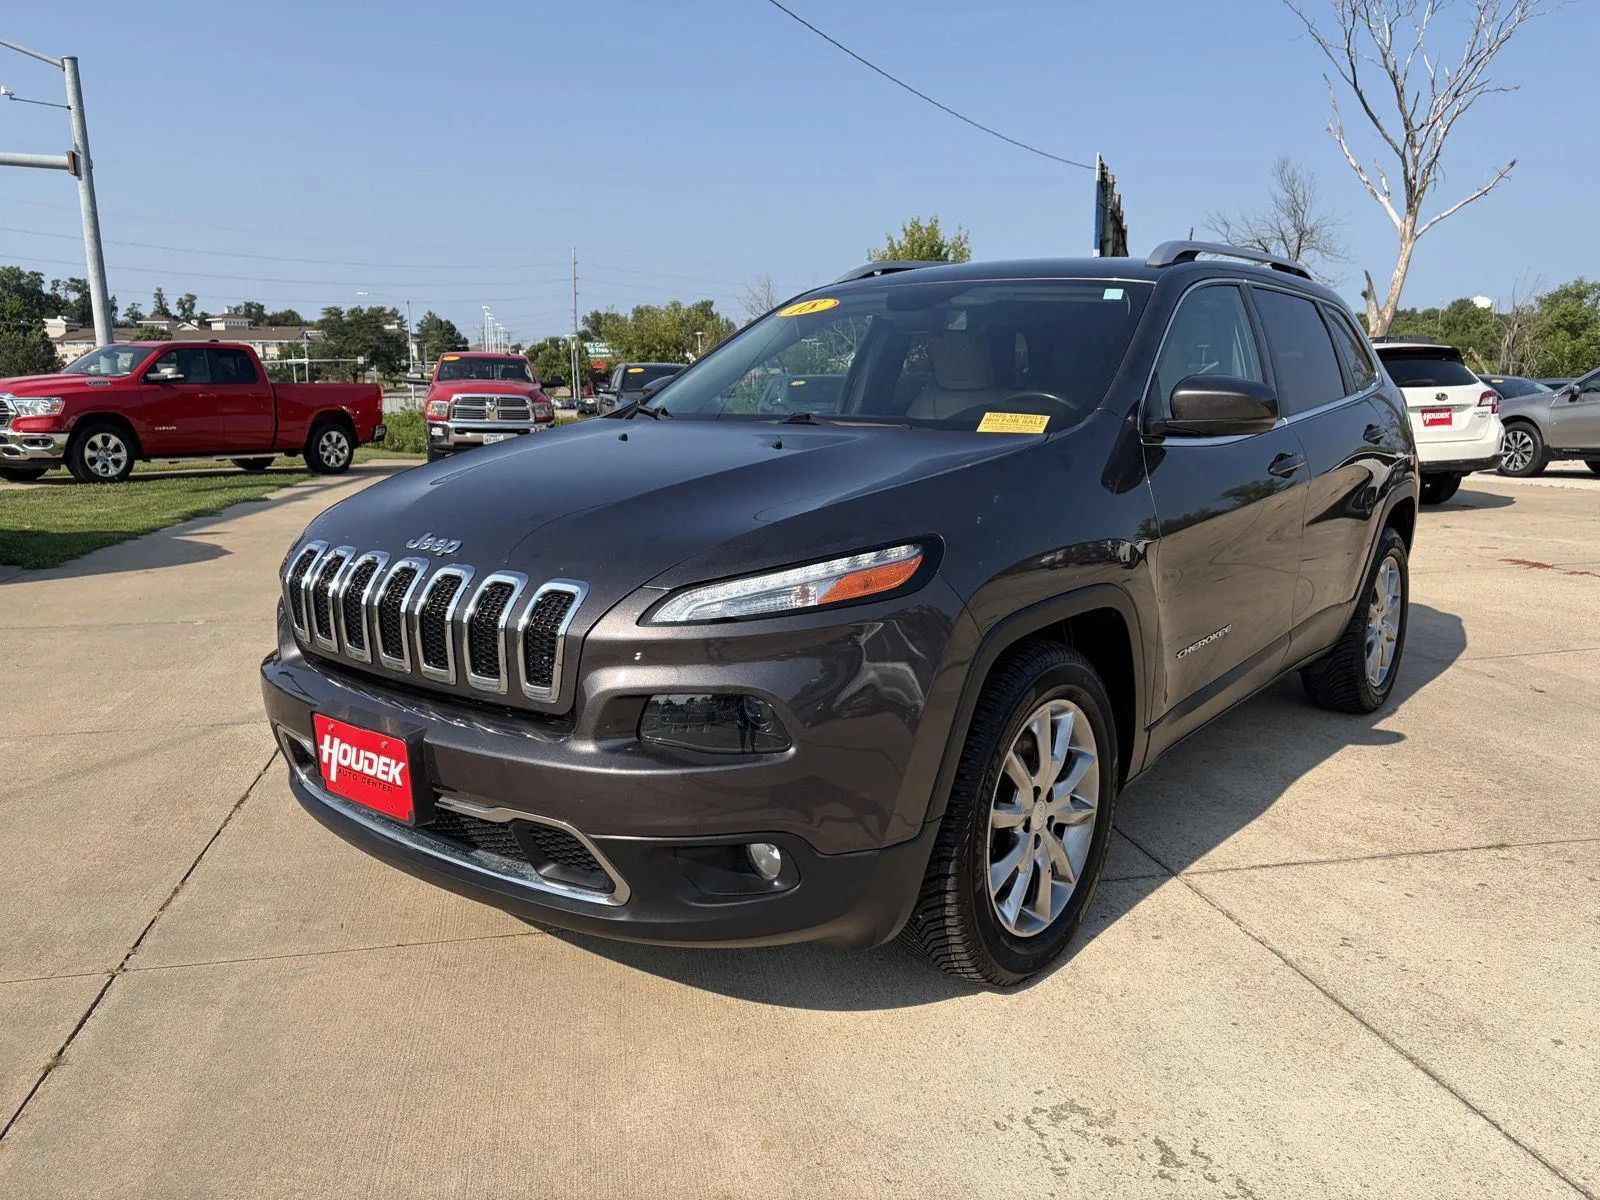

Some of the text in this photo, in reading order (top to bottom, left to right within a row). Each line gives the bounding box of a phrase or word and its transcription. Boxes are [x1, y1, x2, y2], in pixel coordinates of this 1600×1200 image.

[1423, 412, 1451, 424] HOUDEK
[406, 532, 463, 557] Jeep
[1176, 624, 1232, 659] CHEROKEE
[320, 734, 406, 786] HOUDEK
[337, 768, 393, 794] AUTO CENTER
